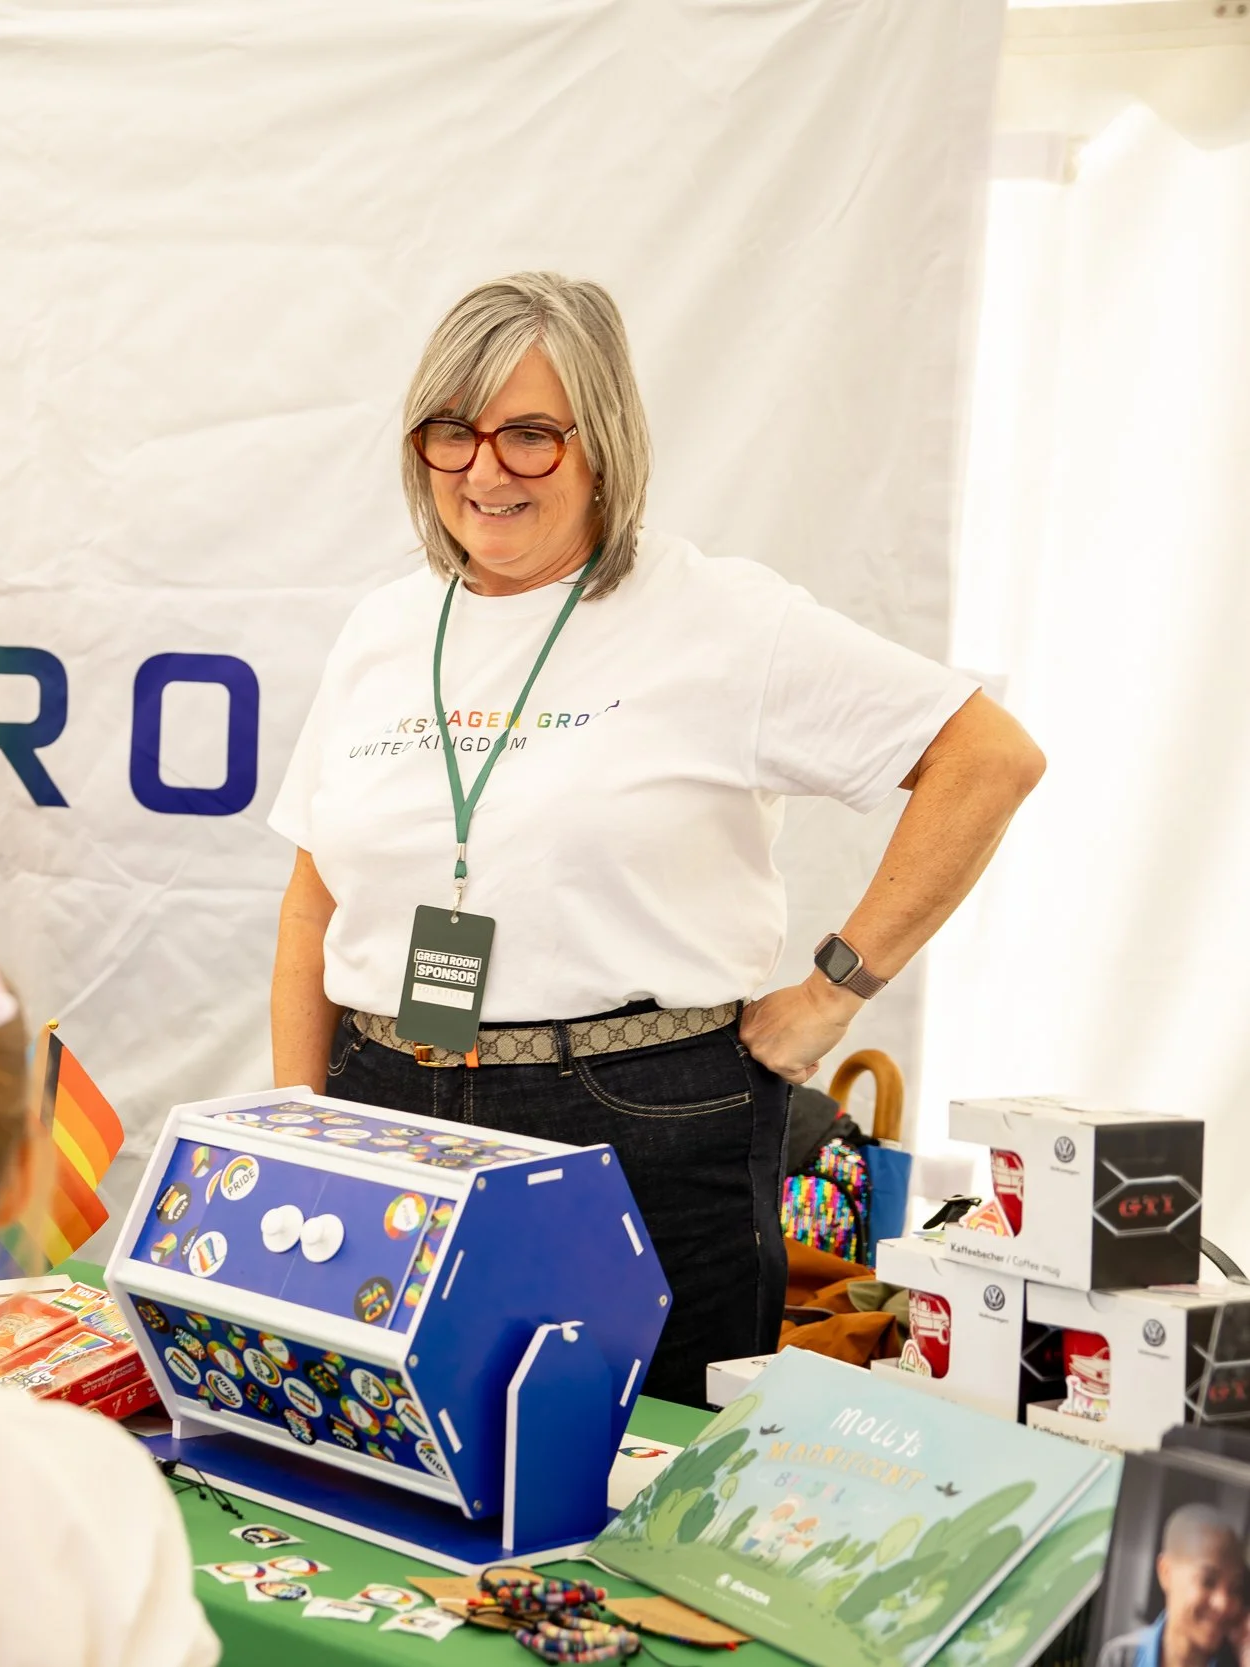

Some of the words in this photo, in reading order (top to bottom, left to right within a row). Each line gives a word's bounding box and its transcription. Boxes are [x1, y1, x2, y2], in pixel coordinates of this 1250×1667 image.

[416, 951, 448, 964] GREEN
[450, 956, 479, 969] ROOM
[417, 964, 476, 984] SPONSOR
[227, 1168, 256, 1197] PRIDE
[1118, 1194, 1174, 1218] GTI
